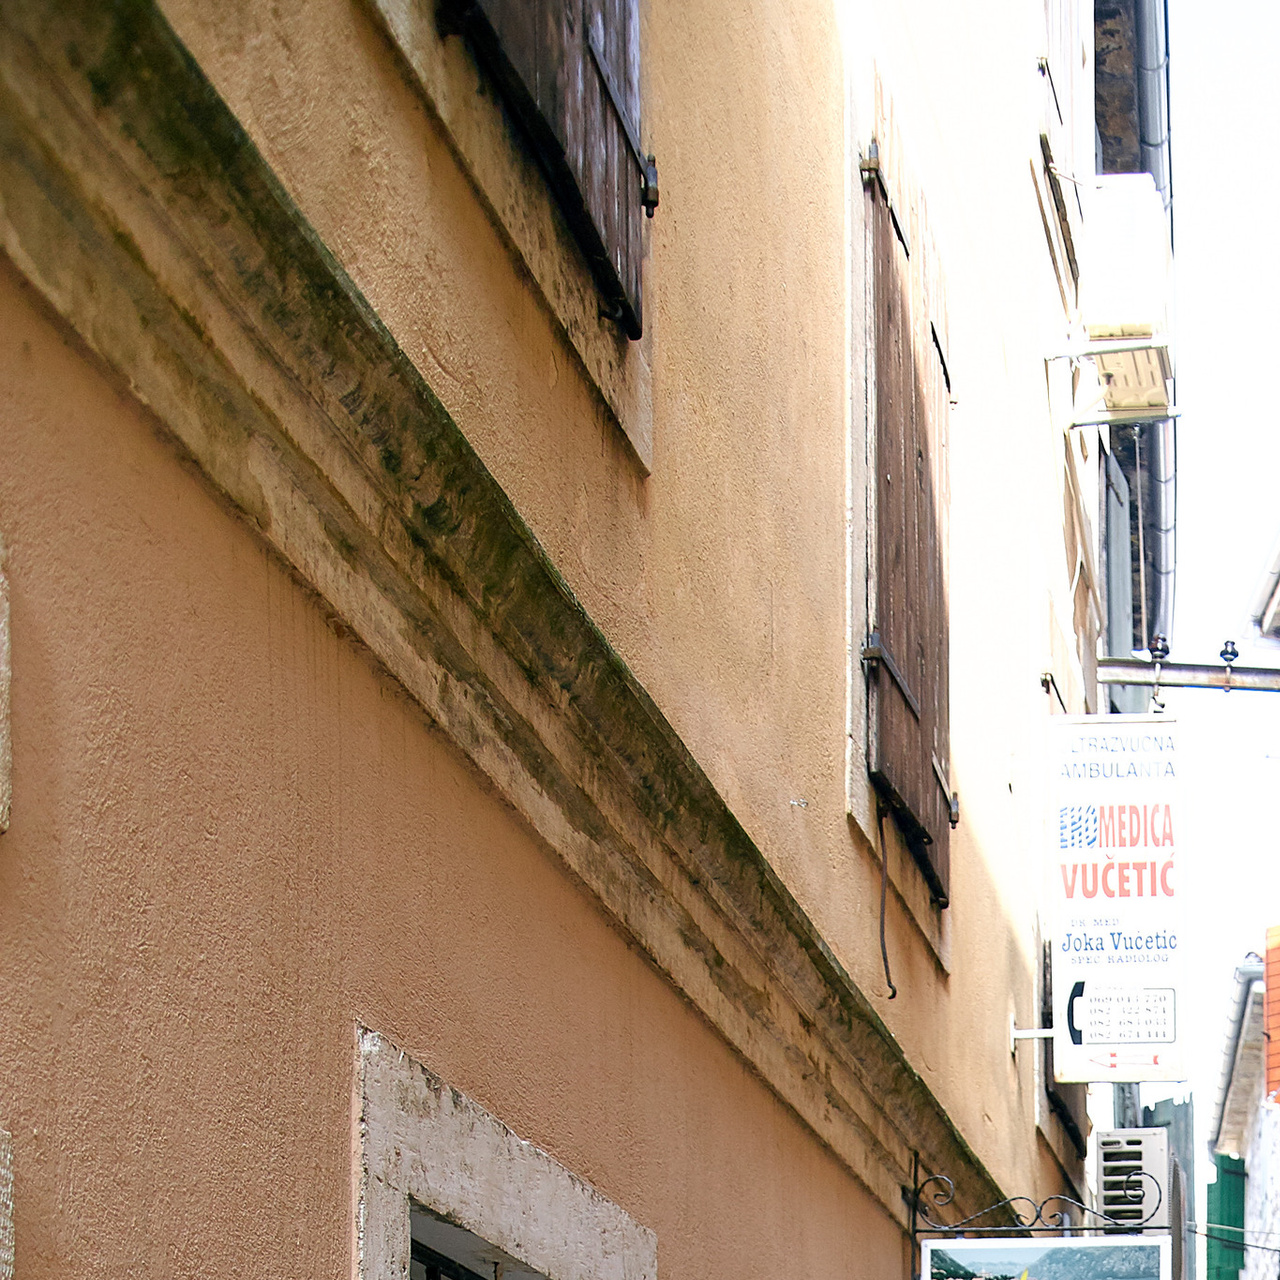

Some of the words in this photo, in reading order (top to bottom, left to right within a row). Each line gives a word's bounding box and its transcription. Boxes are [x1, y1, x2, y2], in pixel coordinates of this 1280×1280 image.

[1060, 761, 1176, 780] AMBULANTA
[1060, 852, 1175, 899] VUČETIĆ
[1061, 932, 1104, 953] Joka
